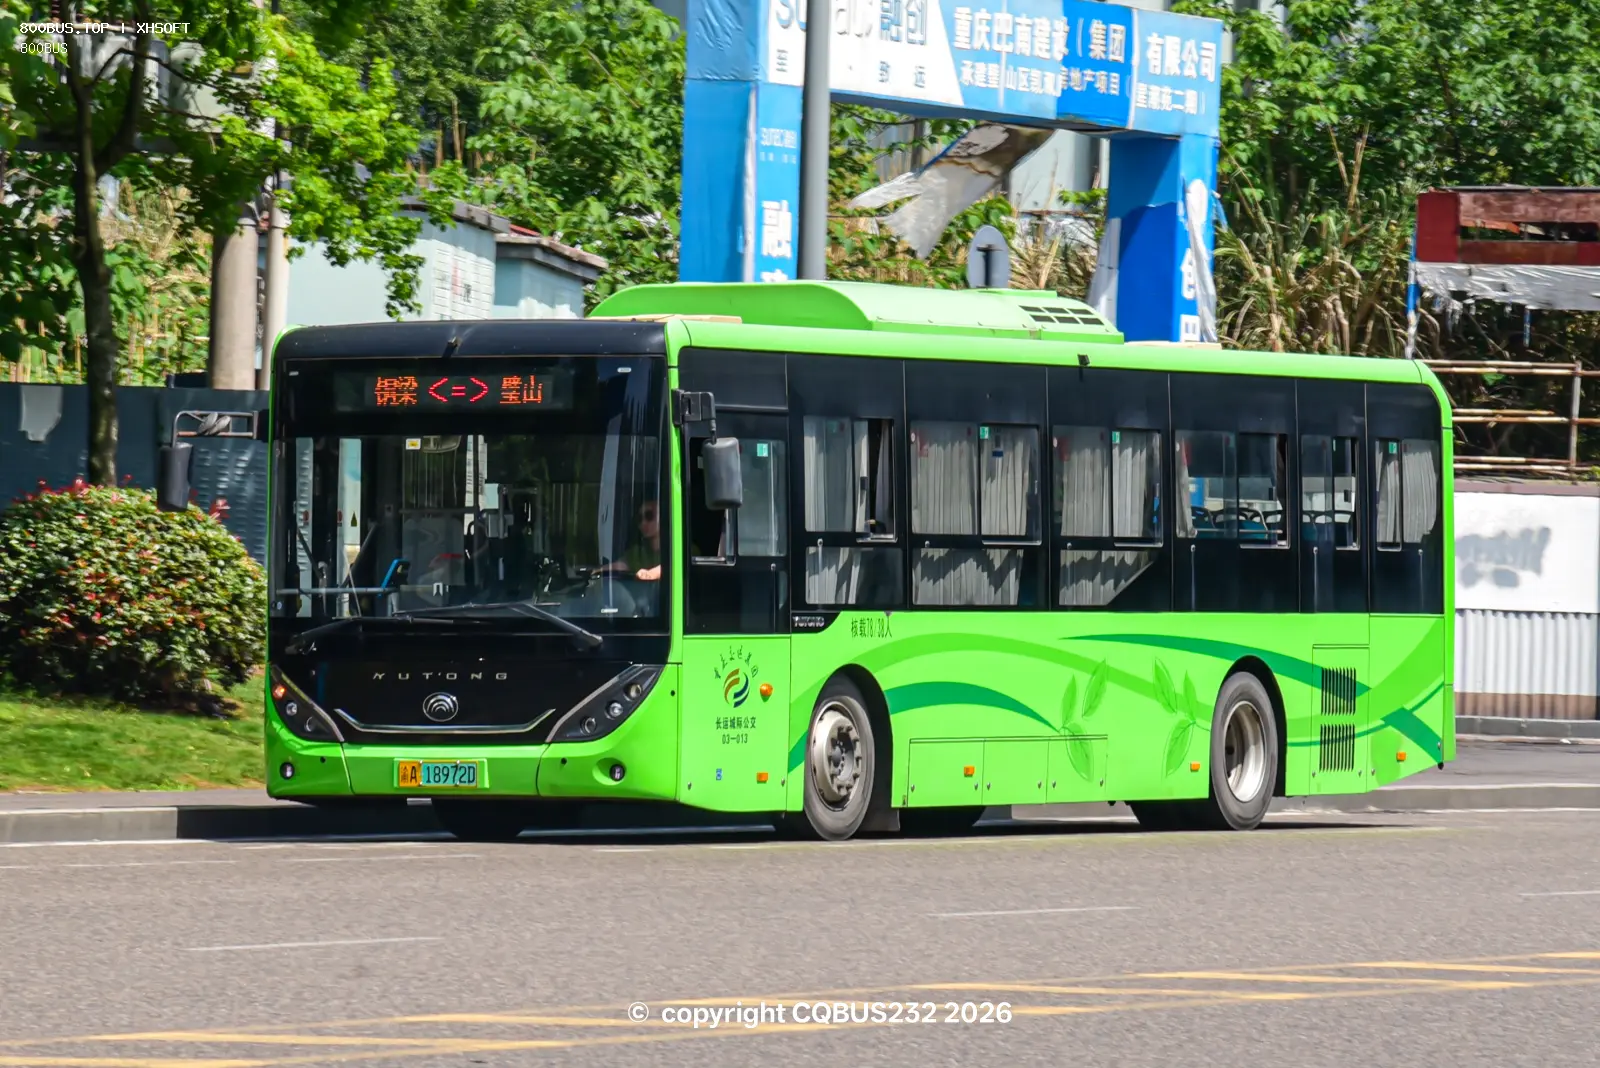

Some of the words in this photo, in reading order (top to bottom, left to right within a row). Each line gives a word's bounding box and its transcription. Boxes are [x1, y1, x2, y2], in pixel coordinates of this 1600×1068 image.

[500, 375, 543, 403] 璧山
[373, 672, 507, 680] YUTONG
[715, 716, 756, 730] 长运城际公交
